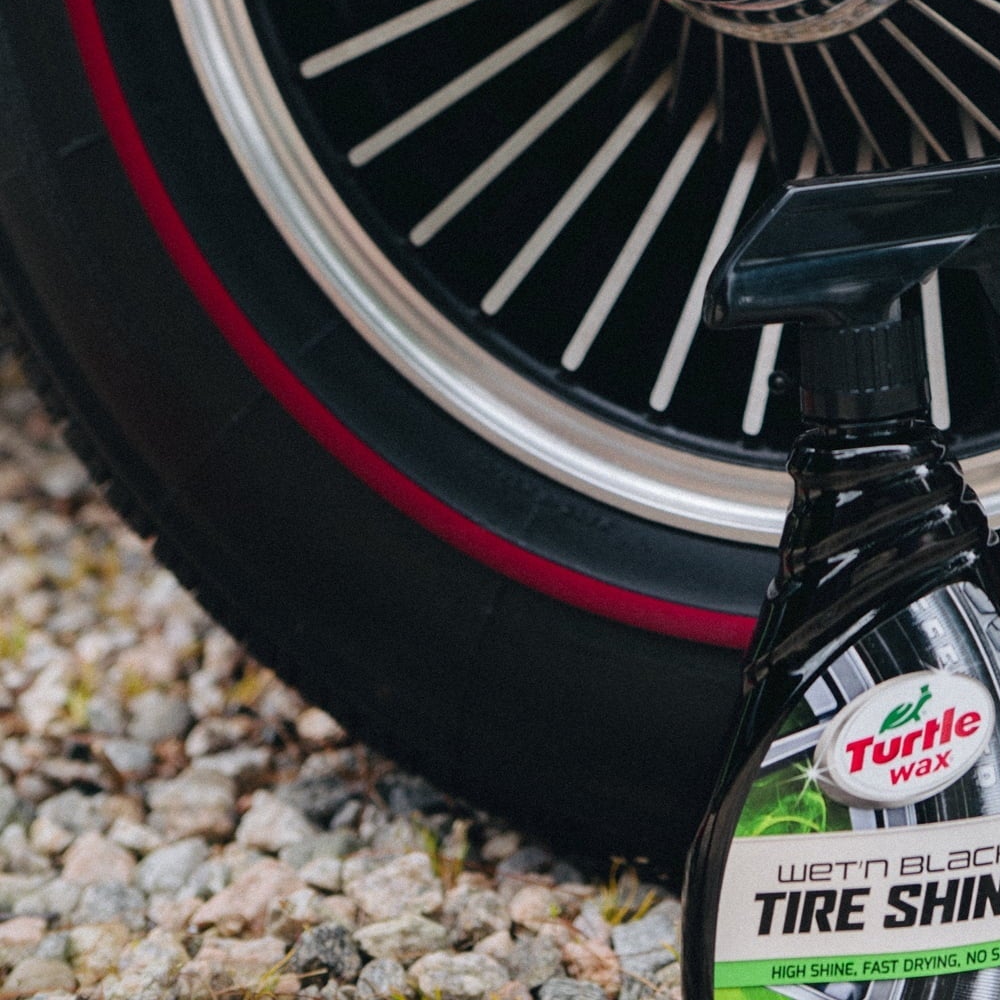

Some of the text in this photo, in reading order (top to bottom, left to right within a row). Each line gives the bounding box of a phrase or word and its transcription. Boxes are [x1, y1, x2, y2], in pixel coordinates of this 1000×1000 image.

[845, 706, 981, 774] Turtle
[889, 750, 953, 786] wax
[754, 887, 871, 936] TIRE
[771, 964, 806, 979] HIGH
[862, 959, 899, 975] FAST
[966, 949, 987, 965] NO
